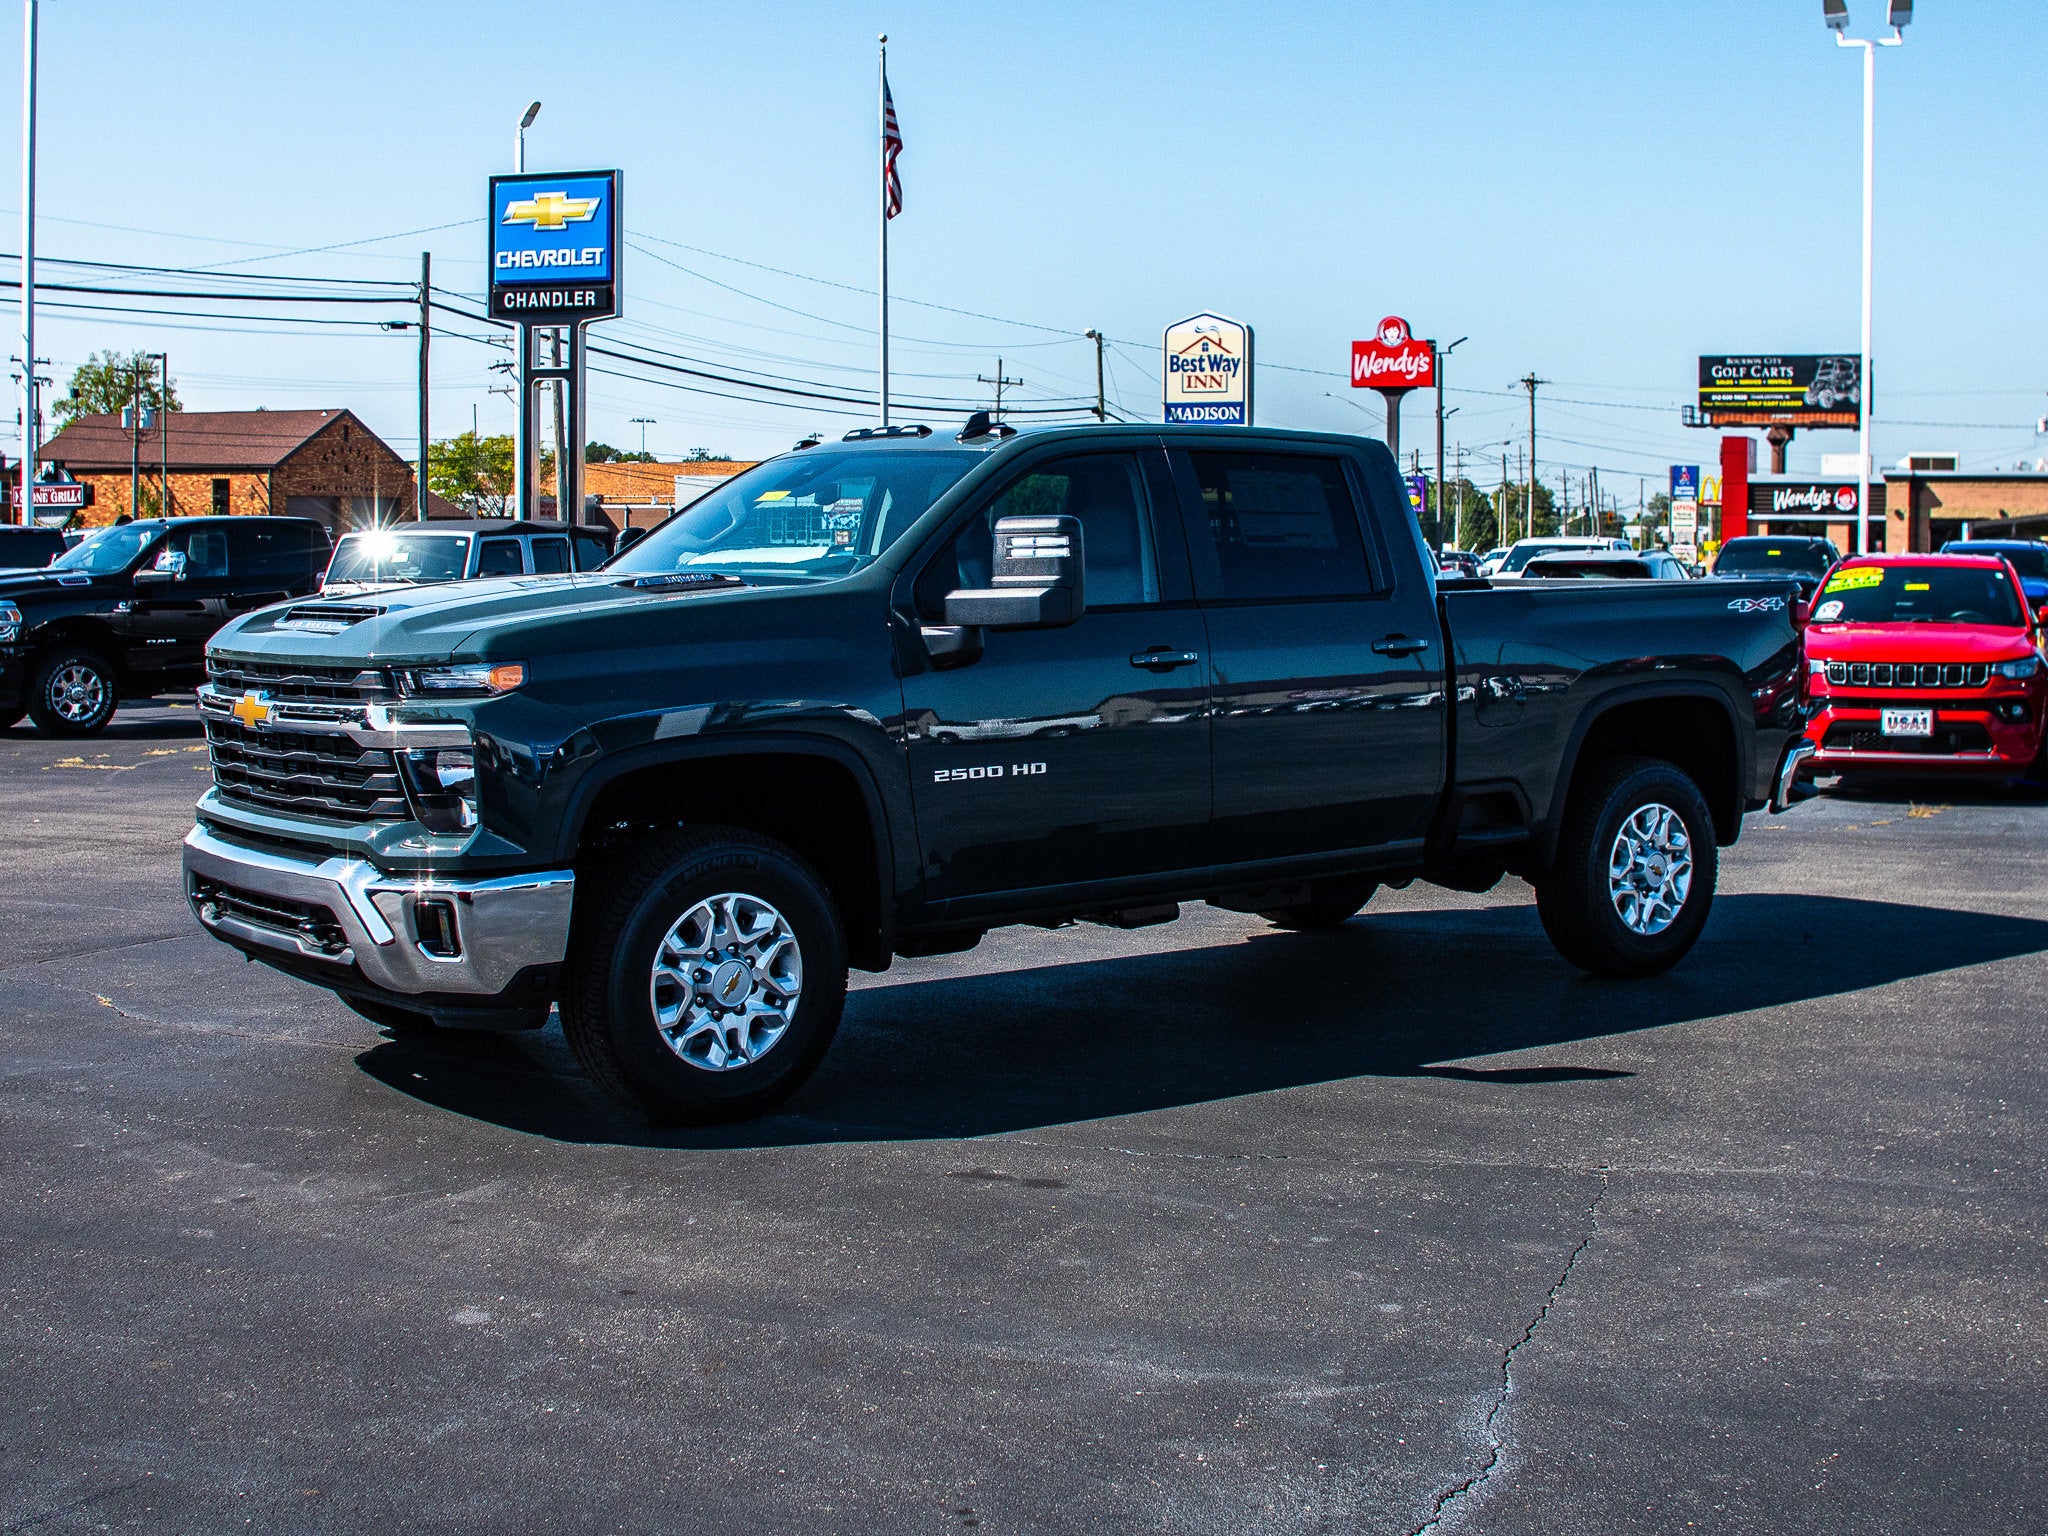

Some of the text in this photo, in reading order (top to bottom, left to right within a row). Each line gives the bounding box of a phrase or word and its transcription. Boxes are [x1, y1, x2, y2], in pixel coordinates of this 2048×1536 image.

[496, 247, 604, 269] CHEVROLET
[504, 290, 596, 308] CHANDLER
[1169, 353, 1241, 378] Best Way
[1354, 346, 1431, 381] Wendy's
[1711, 364, 1794, 378] GOLF CARTS
[1186, 374, 1224, 388] INN
[1168, 406, 1241, 421] MADISON
[50, 489, 77, 503] GRILL
[1773, 485, 1832, 512] Wendy's
[934, 762, 1047, 782] 2500 HD
